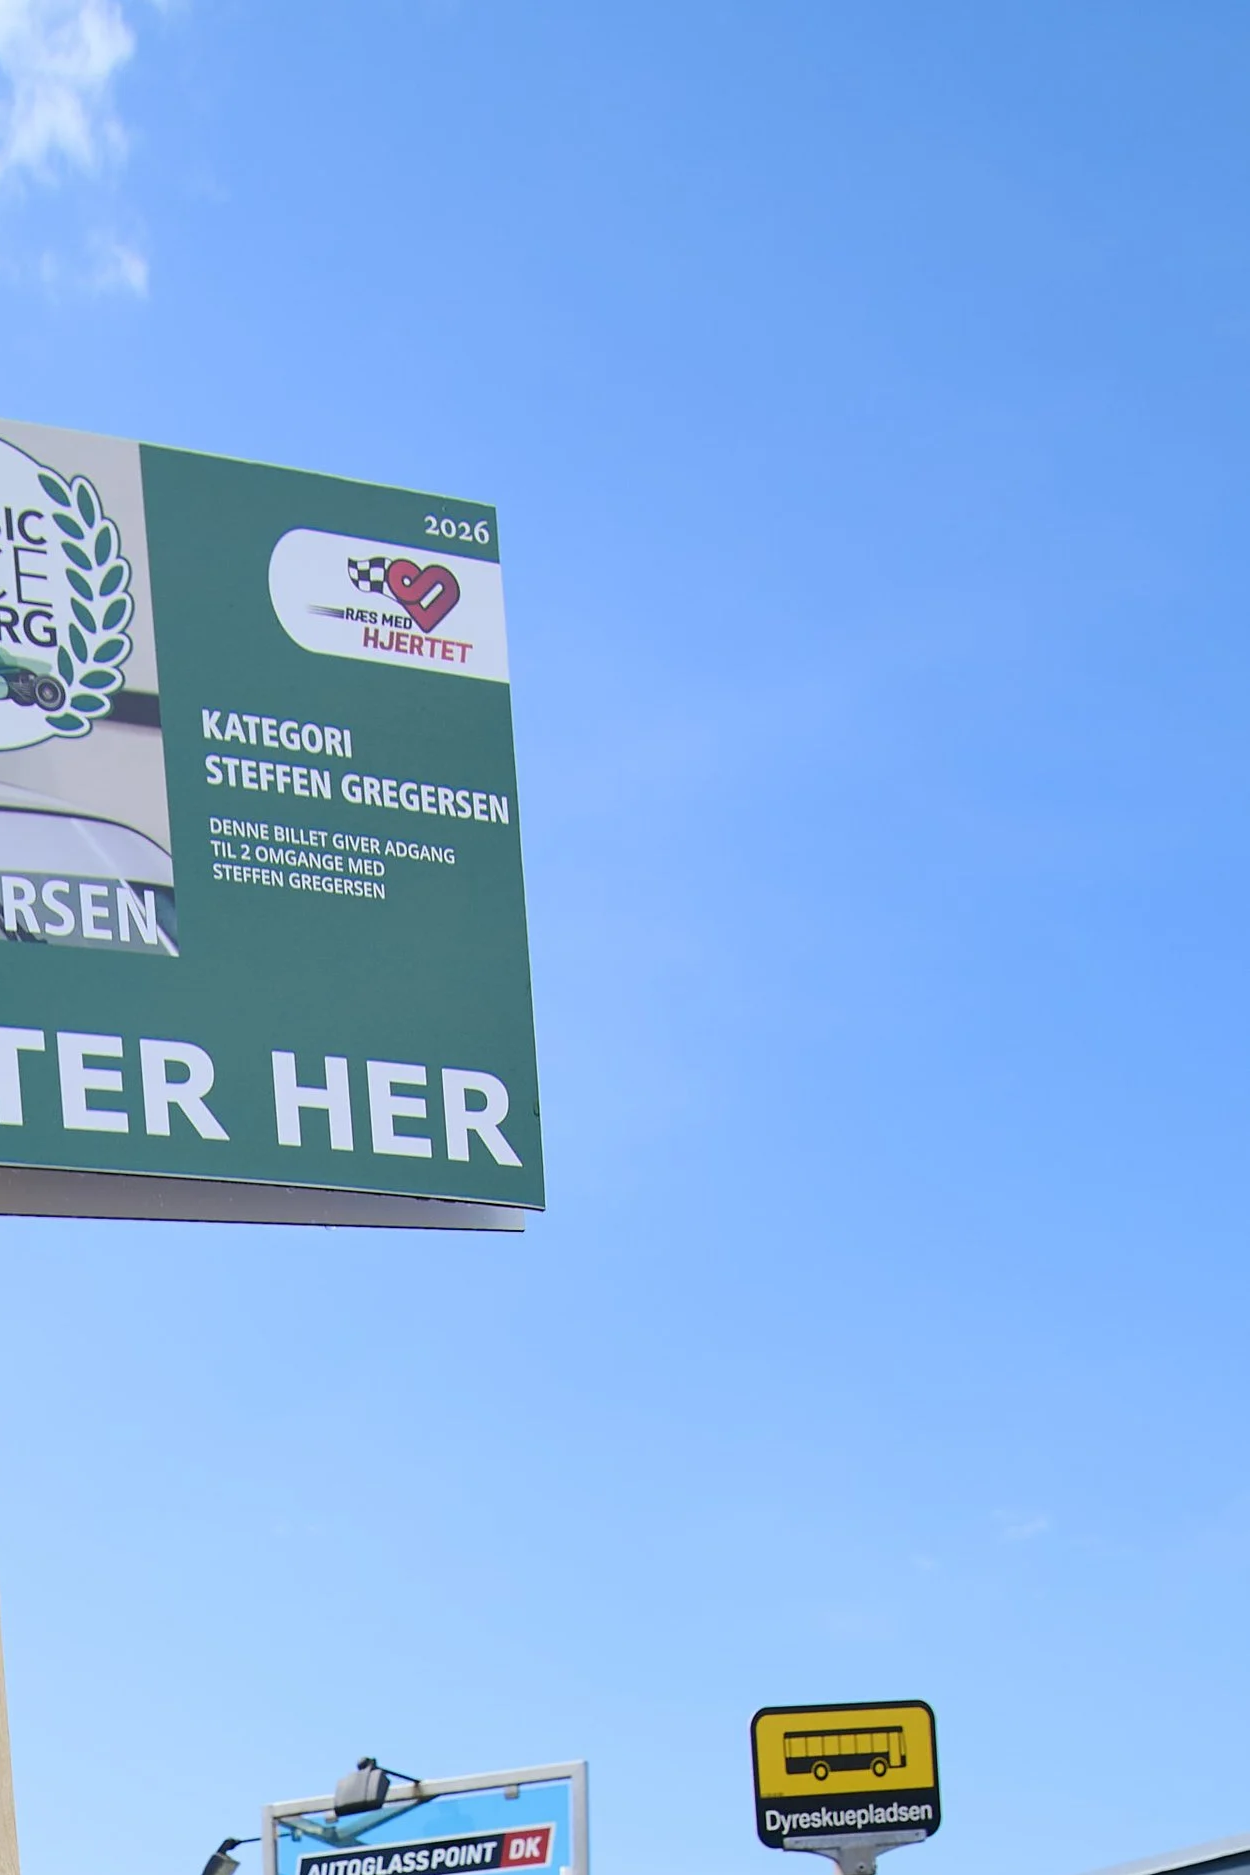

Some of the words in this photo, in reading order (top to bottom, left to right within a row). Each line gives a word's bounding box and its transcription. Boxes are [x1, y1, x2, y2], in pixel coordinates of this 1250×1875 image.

[423, 514, 491, 544] 2026
[345, 607, 379, 626] RÆS
[381, 612, 413, 631] MED
[362, 626, 473, 664] HJERTET
[201, 708, 353, 758] KATEGORI
[205, 754, 332, 800] STEFFEN
[340, 774, 510, 825] GREGERSEN
[209, 817, 270, 841] DENNE
[273, 824, 329, 848] BILLET
[331, 833, 381, 856] GIVER
[384, 839, 456, 865] ADGANG
[210, 839, 237, 860] TIL
[239, 843, 252, 861] 2
[254, 844, 344, 873] OMGANGE
[347, 857, 386, 877] MED
[212, 863, 284, 889] STEFFEN
[288, 872, 386, 900] GREGERSEN
[270, 1049, 524, 1169] HER
[765, 1801, 933, 1836] Dyreskuepladsen
[508, 1835, 543, 1861] DK
